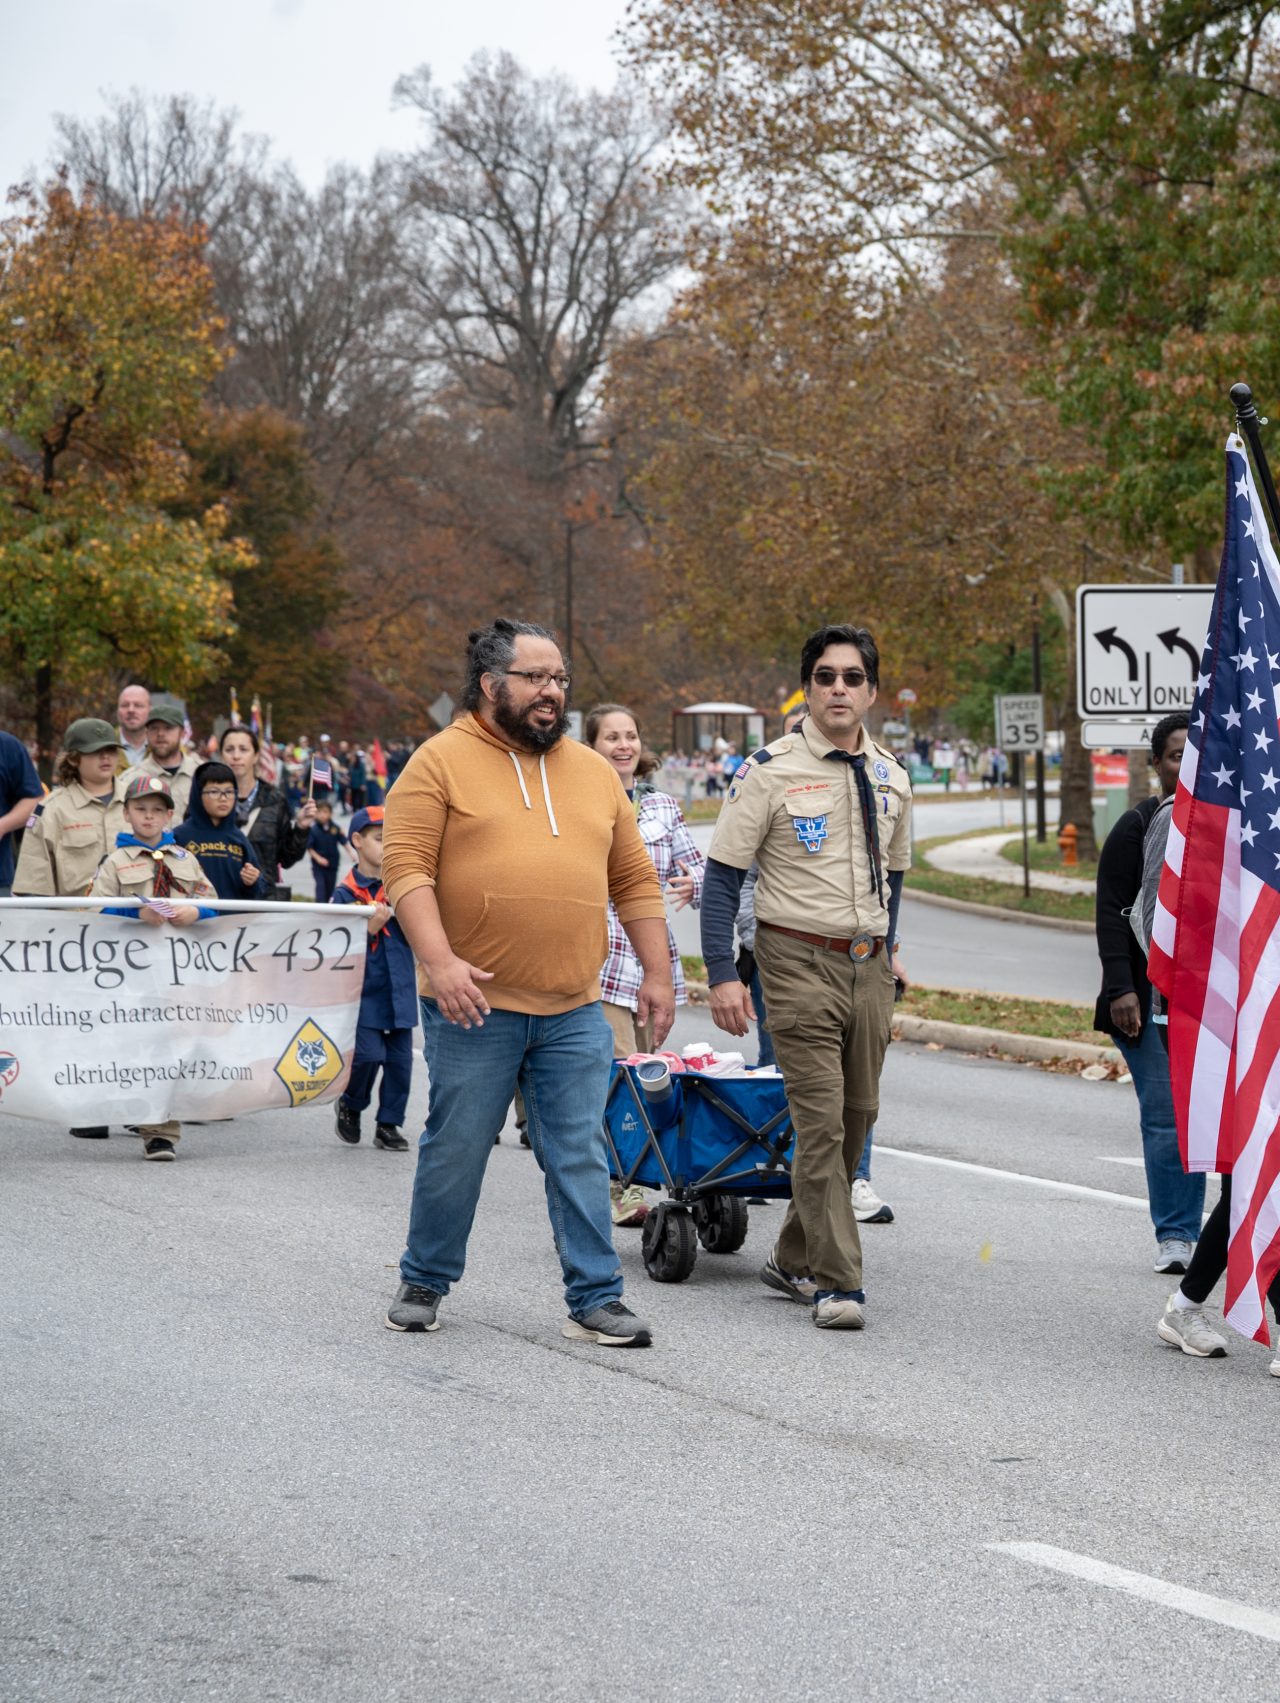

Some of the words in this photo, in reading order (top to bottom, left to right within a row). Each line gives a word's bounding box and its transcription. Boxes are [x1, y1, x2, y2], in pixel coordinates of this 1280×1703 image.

[1003, 701, 1040, 711] SPEED
[1090, 687, 1142, 706] ONLY
[1154, 687, 1196, 705] ONL
[1007, 712, 1036, 722] LIMIT
[1006, 724, 1040, 744] 35
[201, 842, 226, 852] pack
[165, 926, 260, 986] pack
[272, 926, 355, 973] 432
[0, 1003, 94, 1033] building
[100, 1001, 202, 1024] character
[205, 1003, 242, 1024] since
[248, 1002, 288, 1025] 1950
[54, 1058, 254, 1089] elkridgepack432.com
